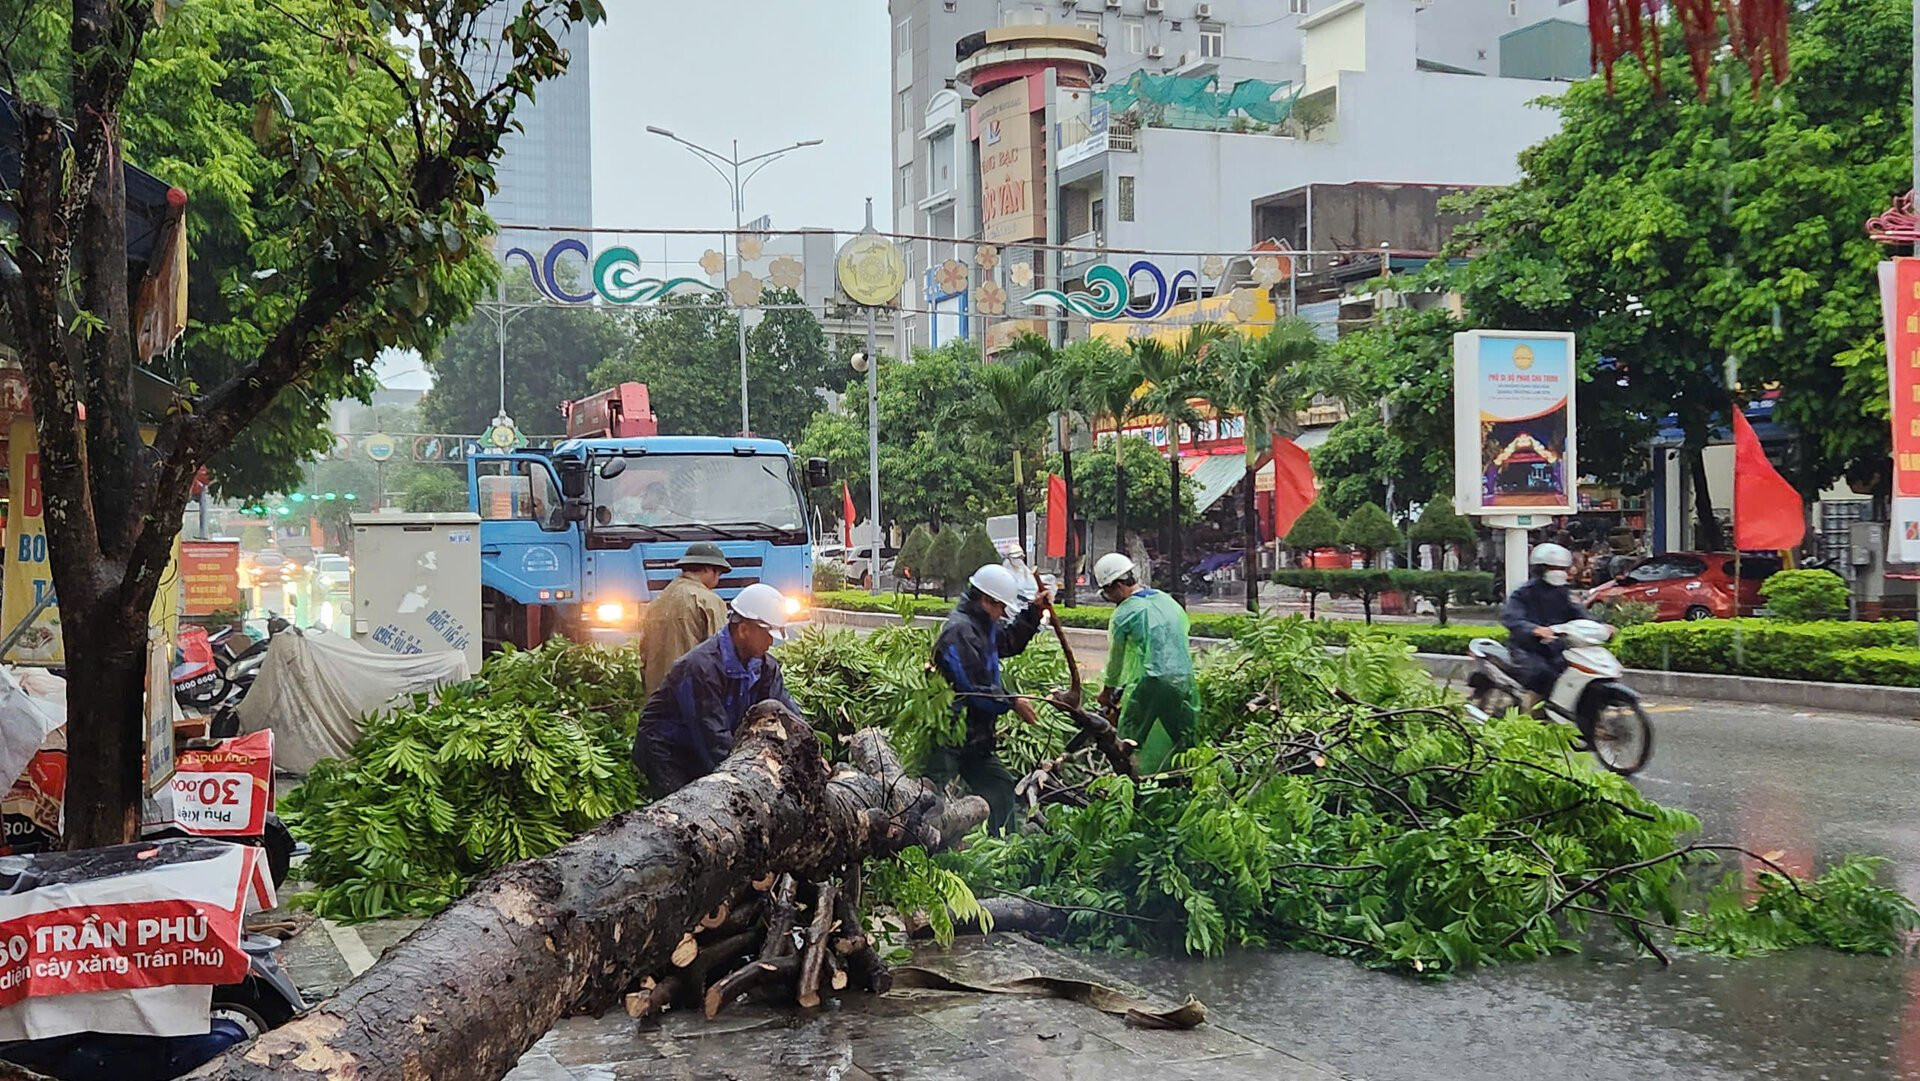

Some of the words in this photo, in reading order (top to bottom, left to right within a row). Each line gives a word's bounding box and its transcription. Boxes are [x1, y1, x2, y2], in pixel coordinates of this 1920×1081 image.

[999, 148, 1018, 168] BẠC
[999, 174, 1025, 217] VÂN
[204, 807, 231, 823] Phụ
[34, 913, 127, 954] TRẦN
[138, 908, 208, 946] PHÚ
[36, 957, 73, 979] cây
[77, 954, 129, 975] xăng
[135, 948, 178, 969] Trần
[182, 947, 223, 967] Phú)
